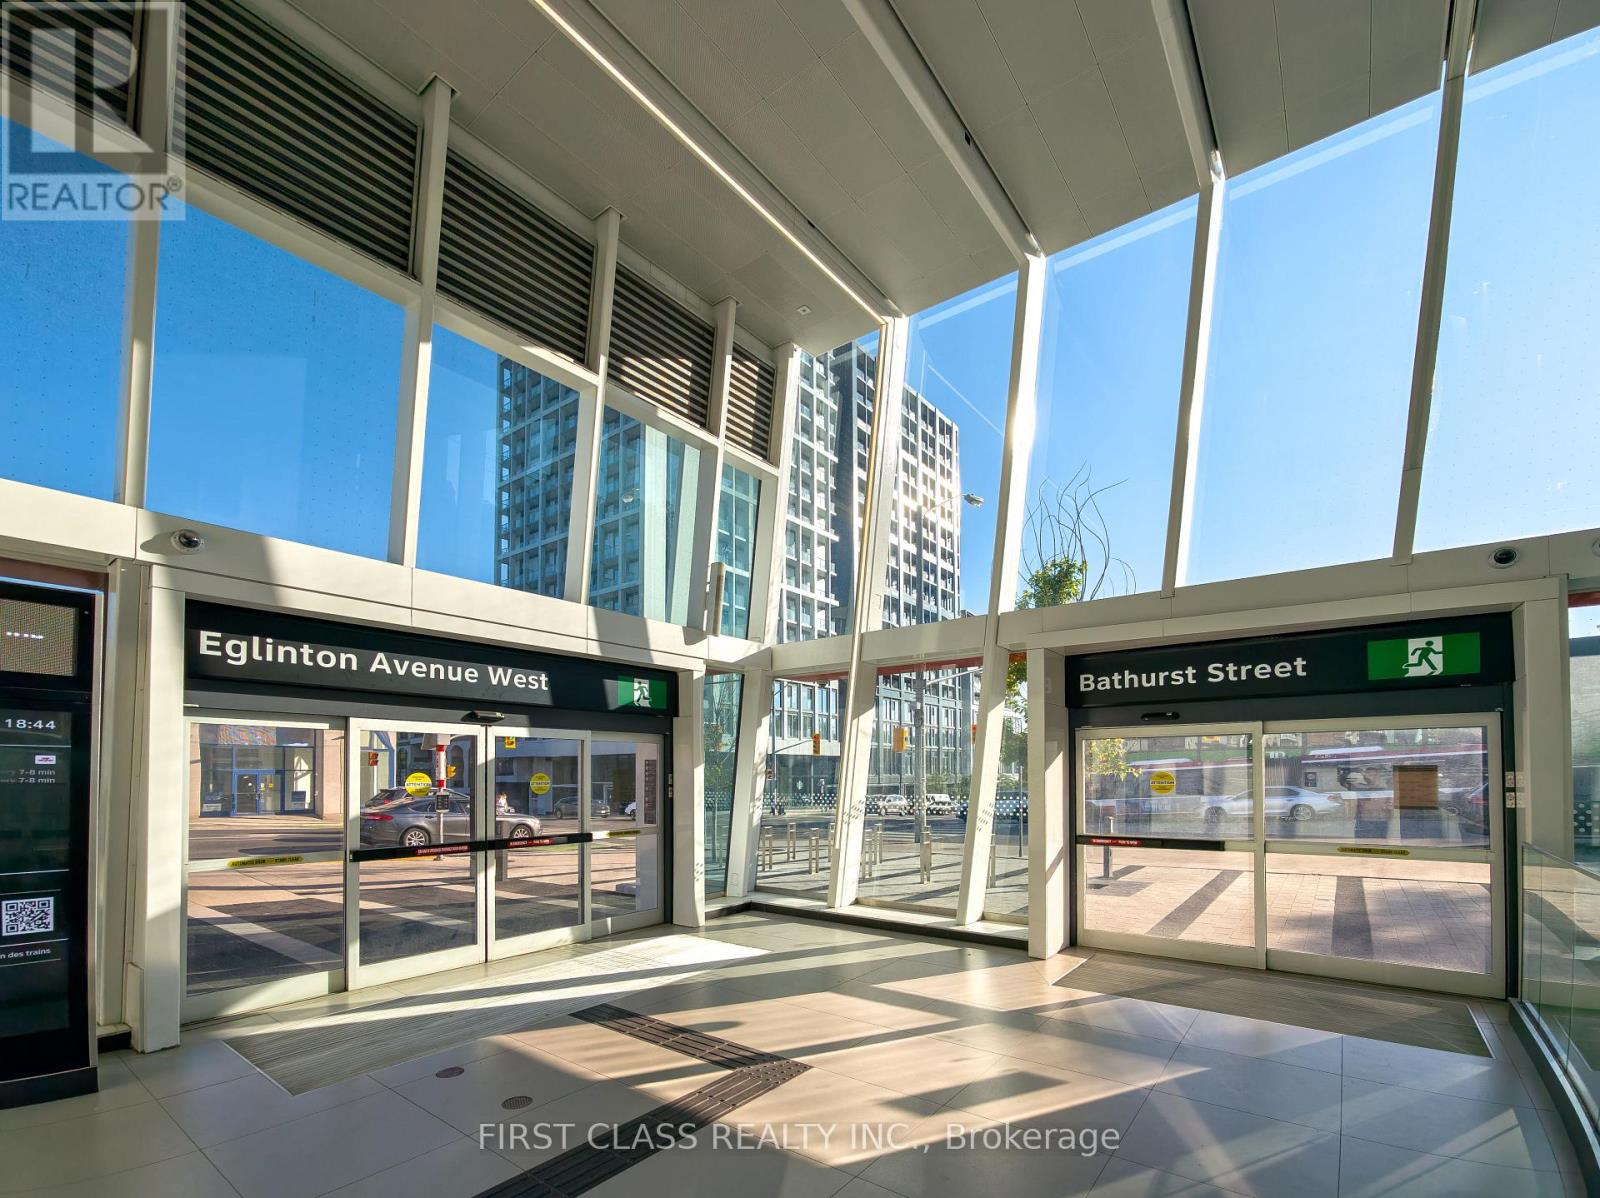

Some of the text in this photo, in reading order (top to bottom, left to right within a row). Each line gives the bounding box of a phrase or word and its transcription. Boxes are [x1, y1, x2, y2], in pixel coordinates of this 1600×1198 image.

[199, 630, 549, 692] Eglinton Avenue West
[1079, 656, 1307, 693] Bathurst Street
[5, 718, 56, 729] 18:44
[8, 949, 24, 960] des
[26, 947, 51, 958] trains
